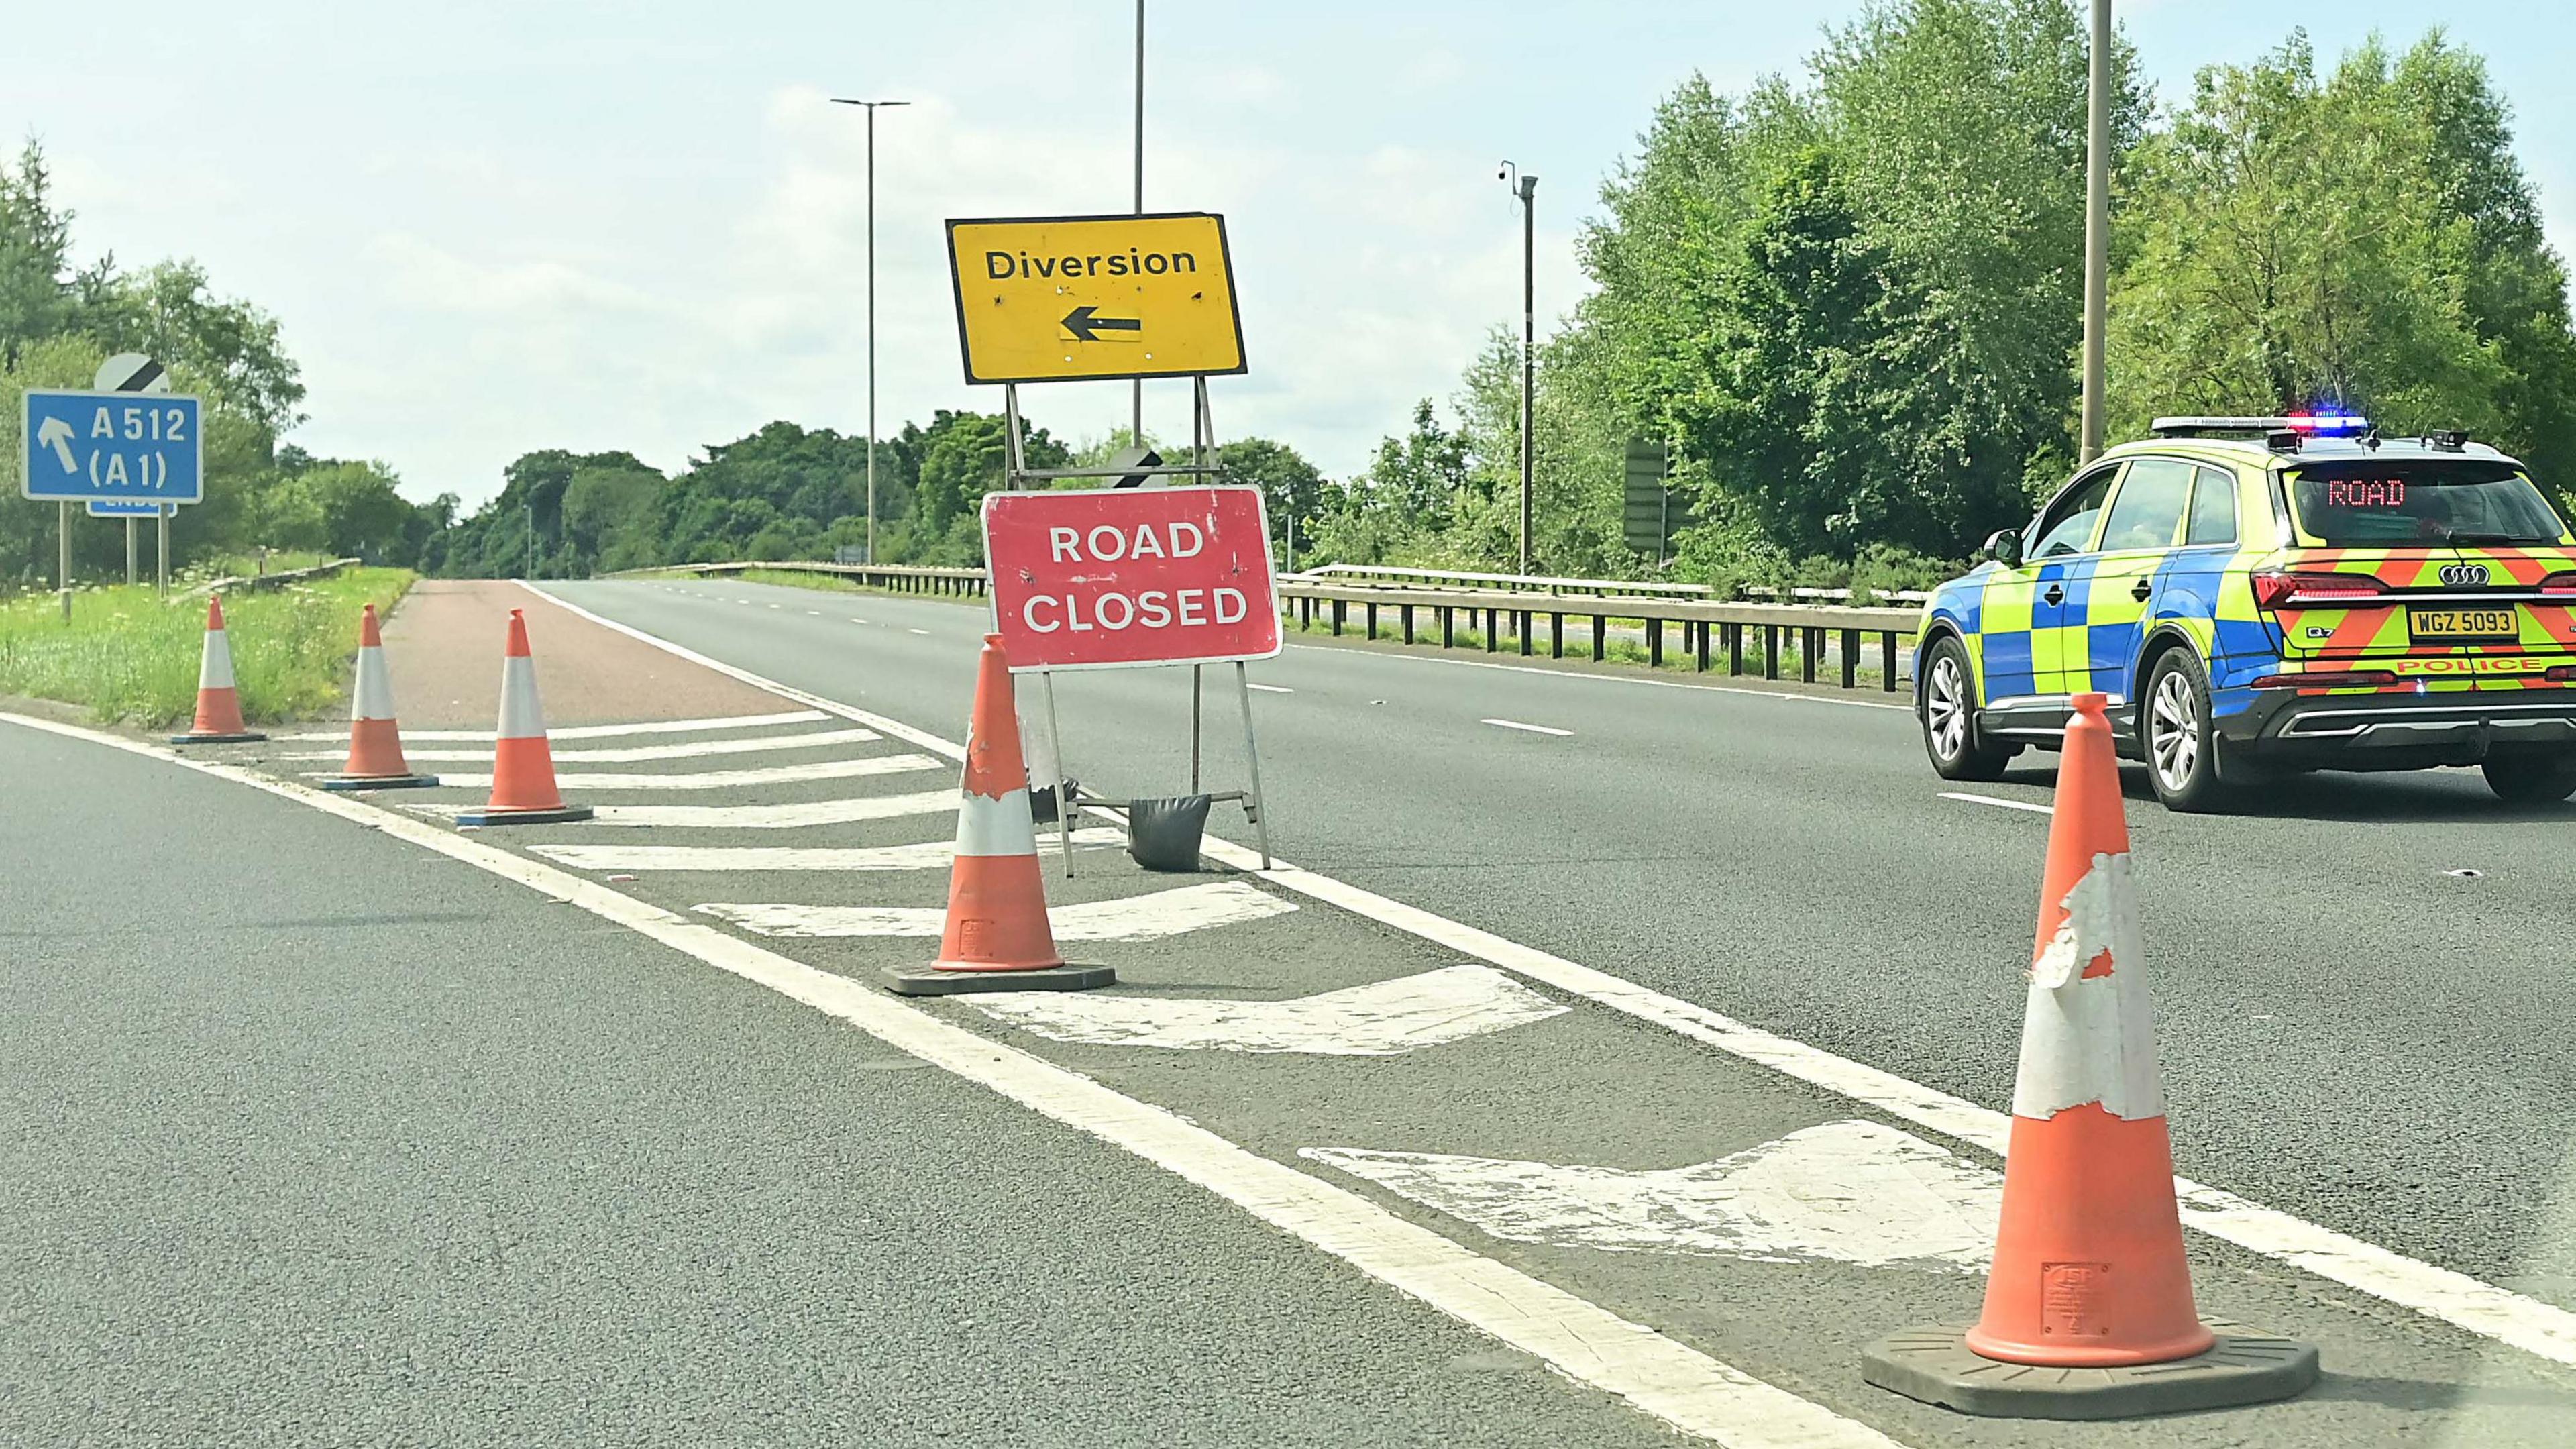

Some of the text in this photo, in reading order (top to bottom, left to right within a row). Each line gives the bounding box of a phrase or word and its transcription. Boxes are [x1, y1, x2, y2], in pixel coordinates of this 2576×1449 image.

[985, 247, 1196, 279] Diversion
[2329, 480, 2404, 506] ROAD
[1049, 522, 1203, 563] ROAD
[1022, 588, 1247, 633] CLOSED
[2418, 612, 2510, 633] WGZ 5093
[2308, 627, 2334, 637] Q7
[2396, 659, 2543, 672] POLICE
